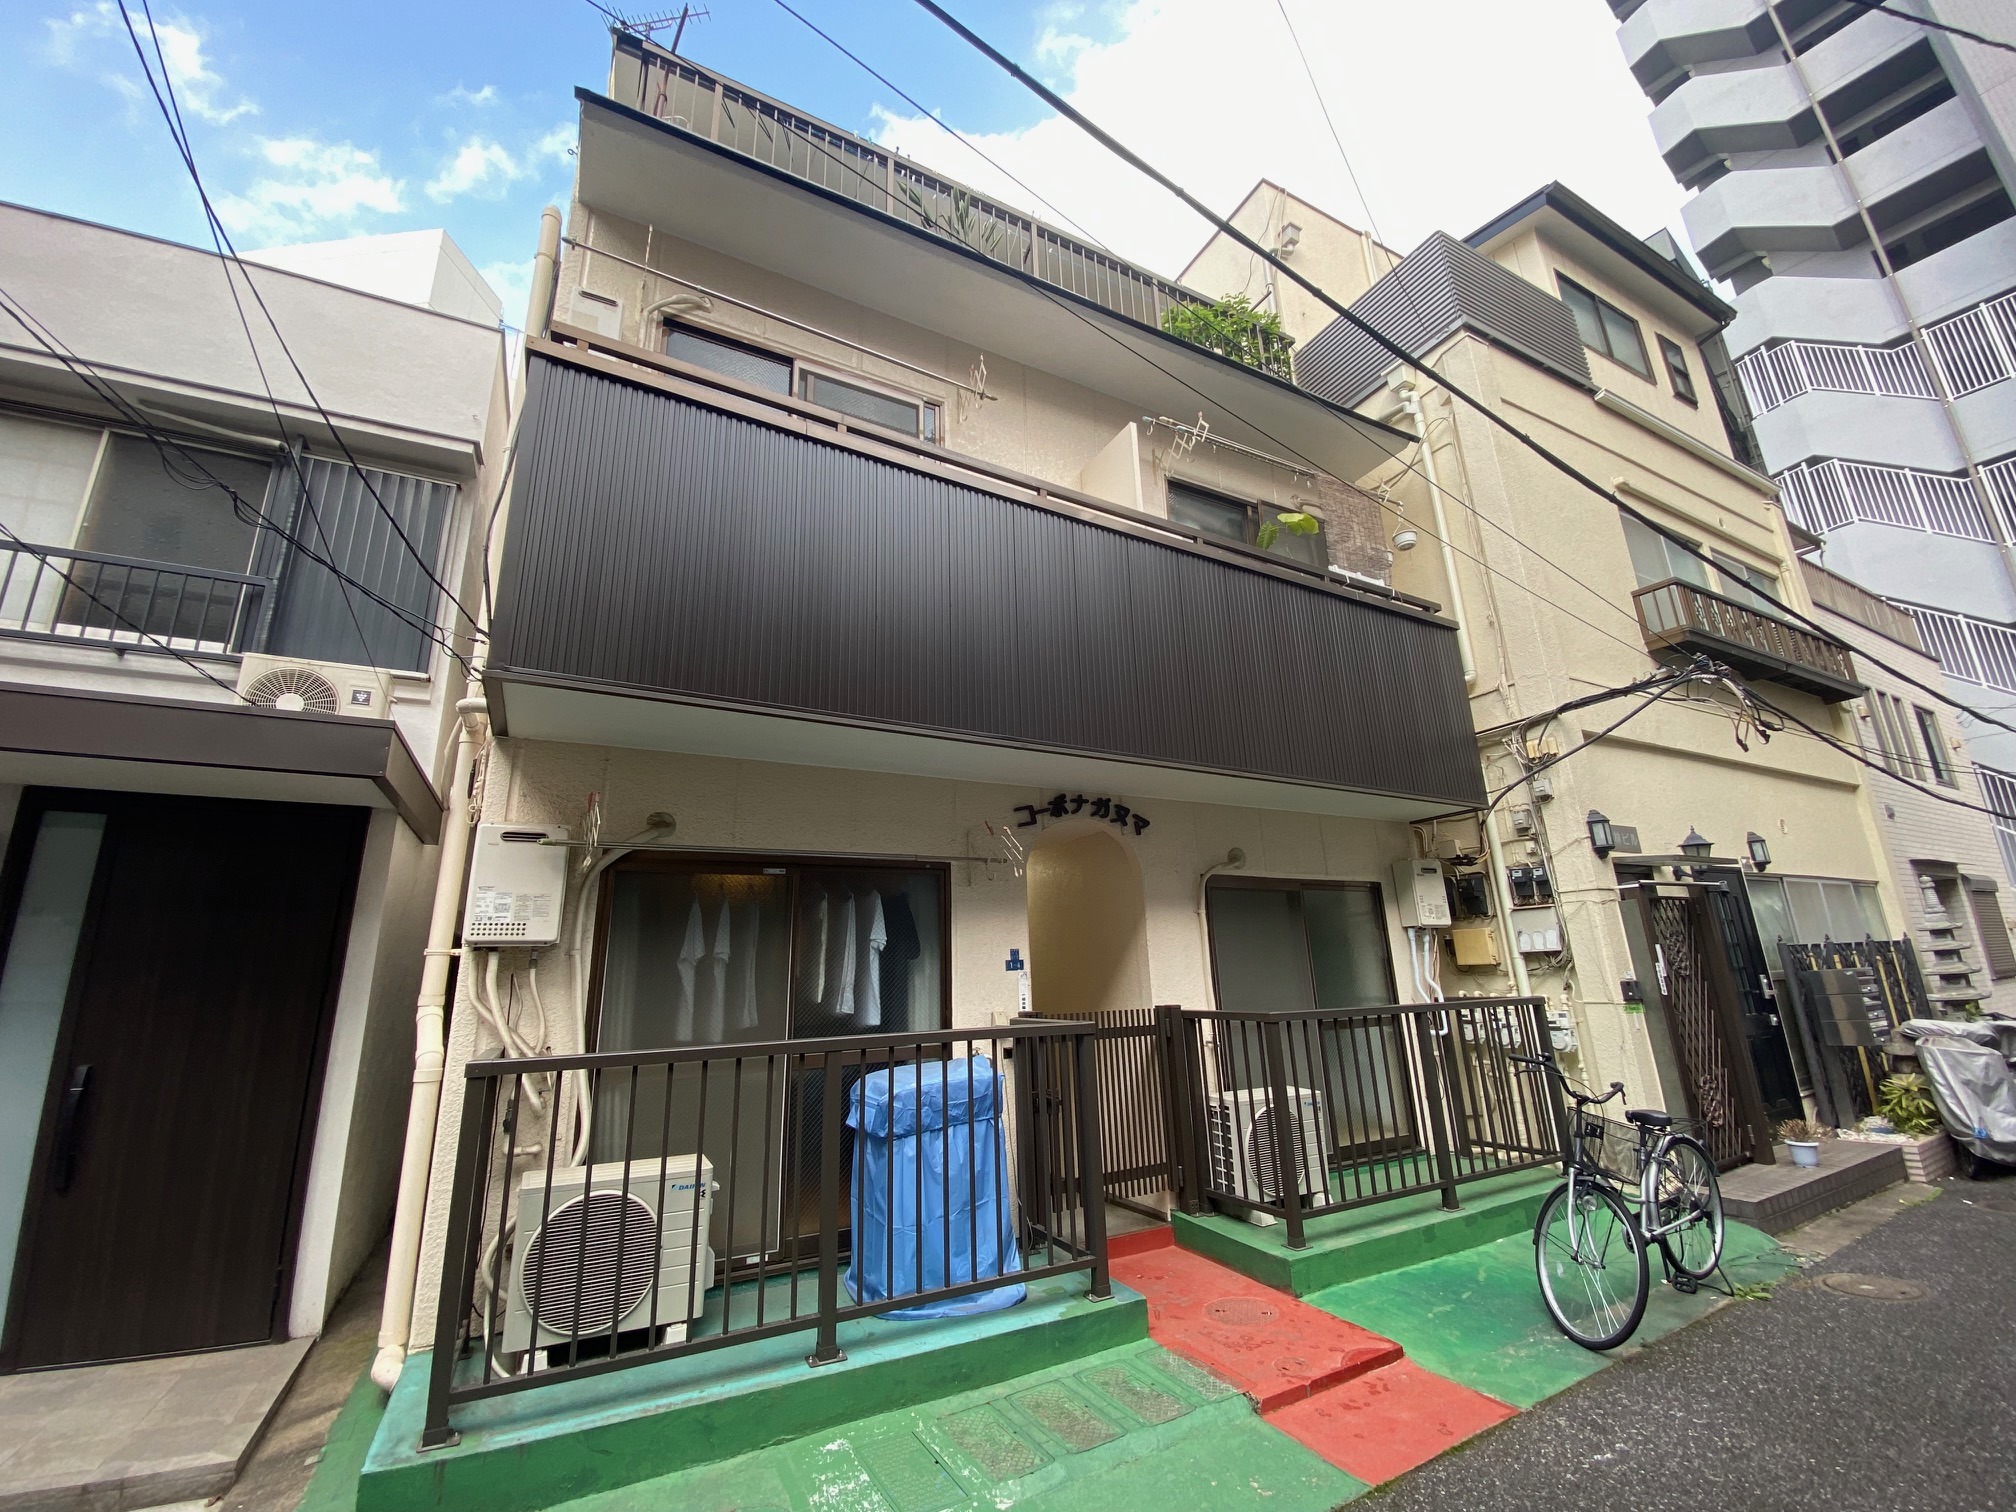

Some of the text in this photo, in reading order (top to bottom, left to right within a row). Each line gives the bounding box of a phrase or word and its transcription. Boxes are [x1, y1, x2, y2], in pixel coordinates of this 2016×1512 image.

[1013, 793, 1150, 836] コーポナガヌマ
[678, 1182, 706, 1191] DAIN
